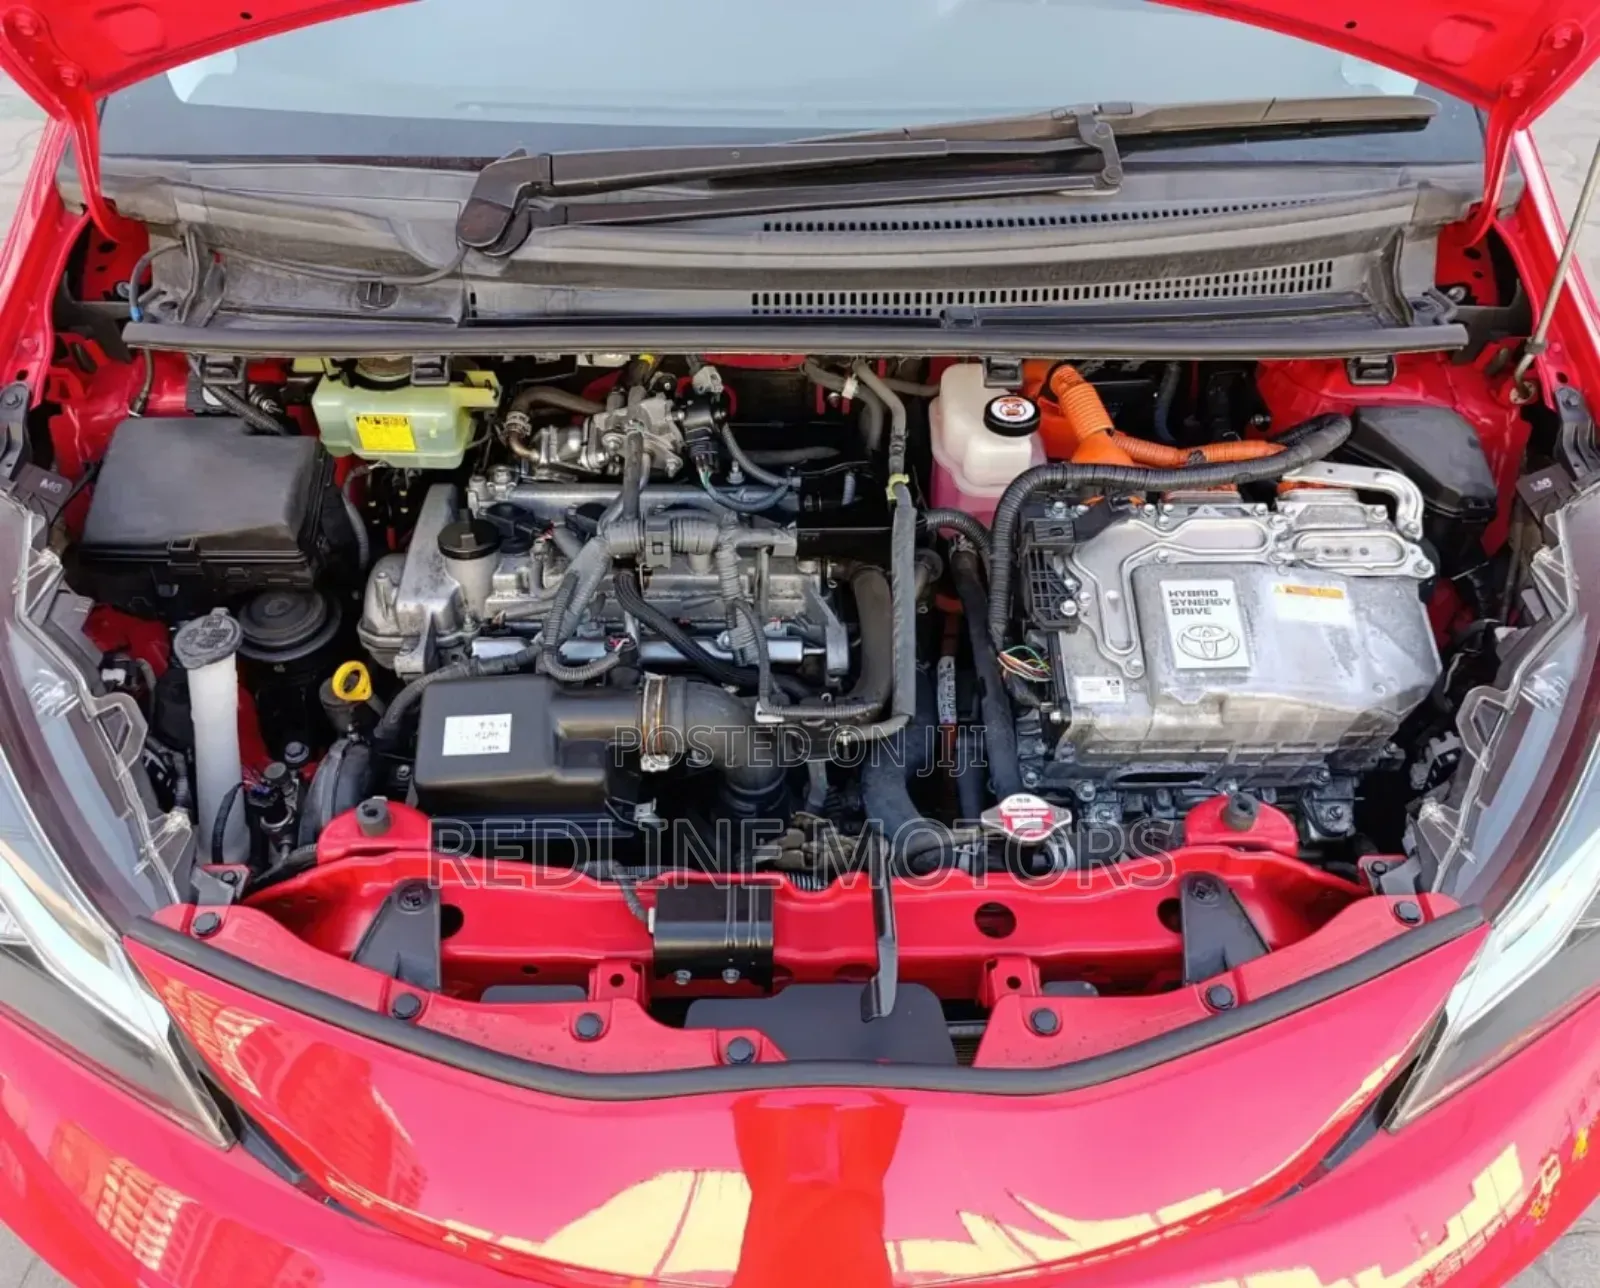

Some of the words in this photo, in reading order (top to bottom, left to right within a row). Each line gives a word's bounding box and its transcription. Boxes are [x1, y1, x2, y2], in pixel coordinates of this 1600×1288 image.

[1168, 589, 1219, 597] HYBRID
[1170, 598, 1231, 606] SYNERGY
[1172, 607, 1212, 615] DRIVE
